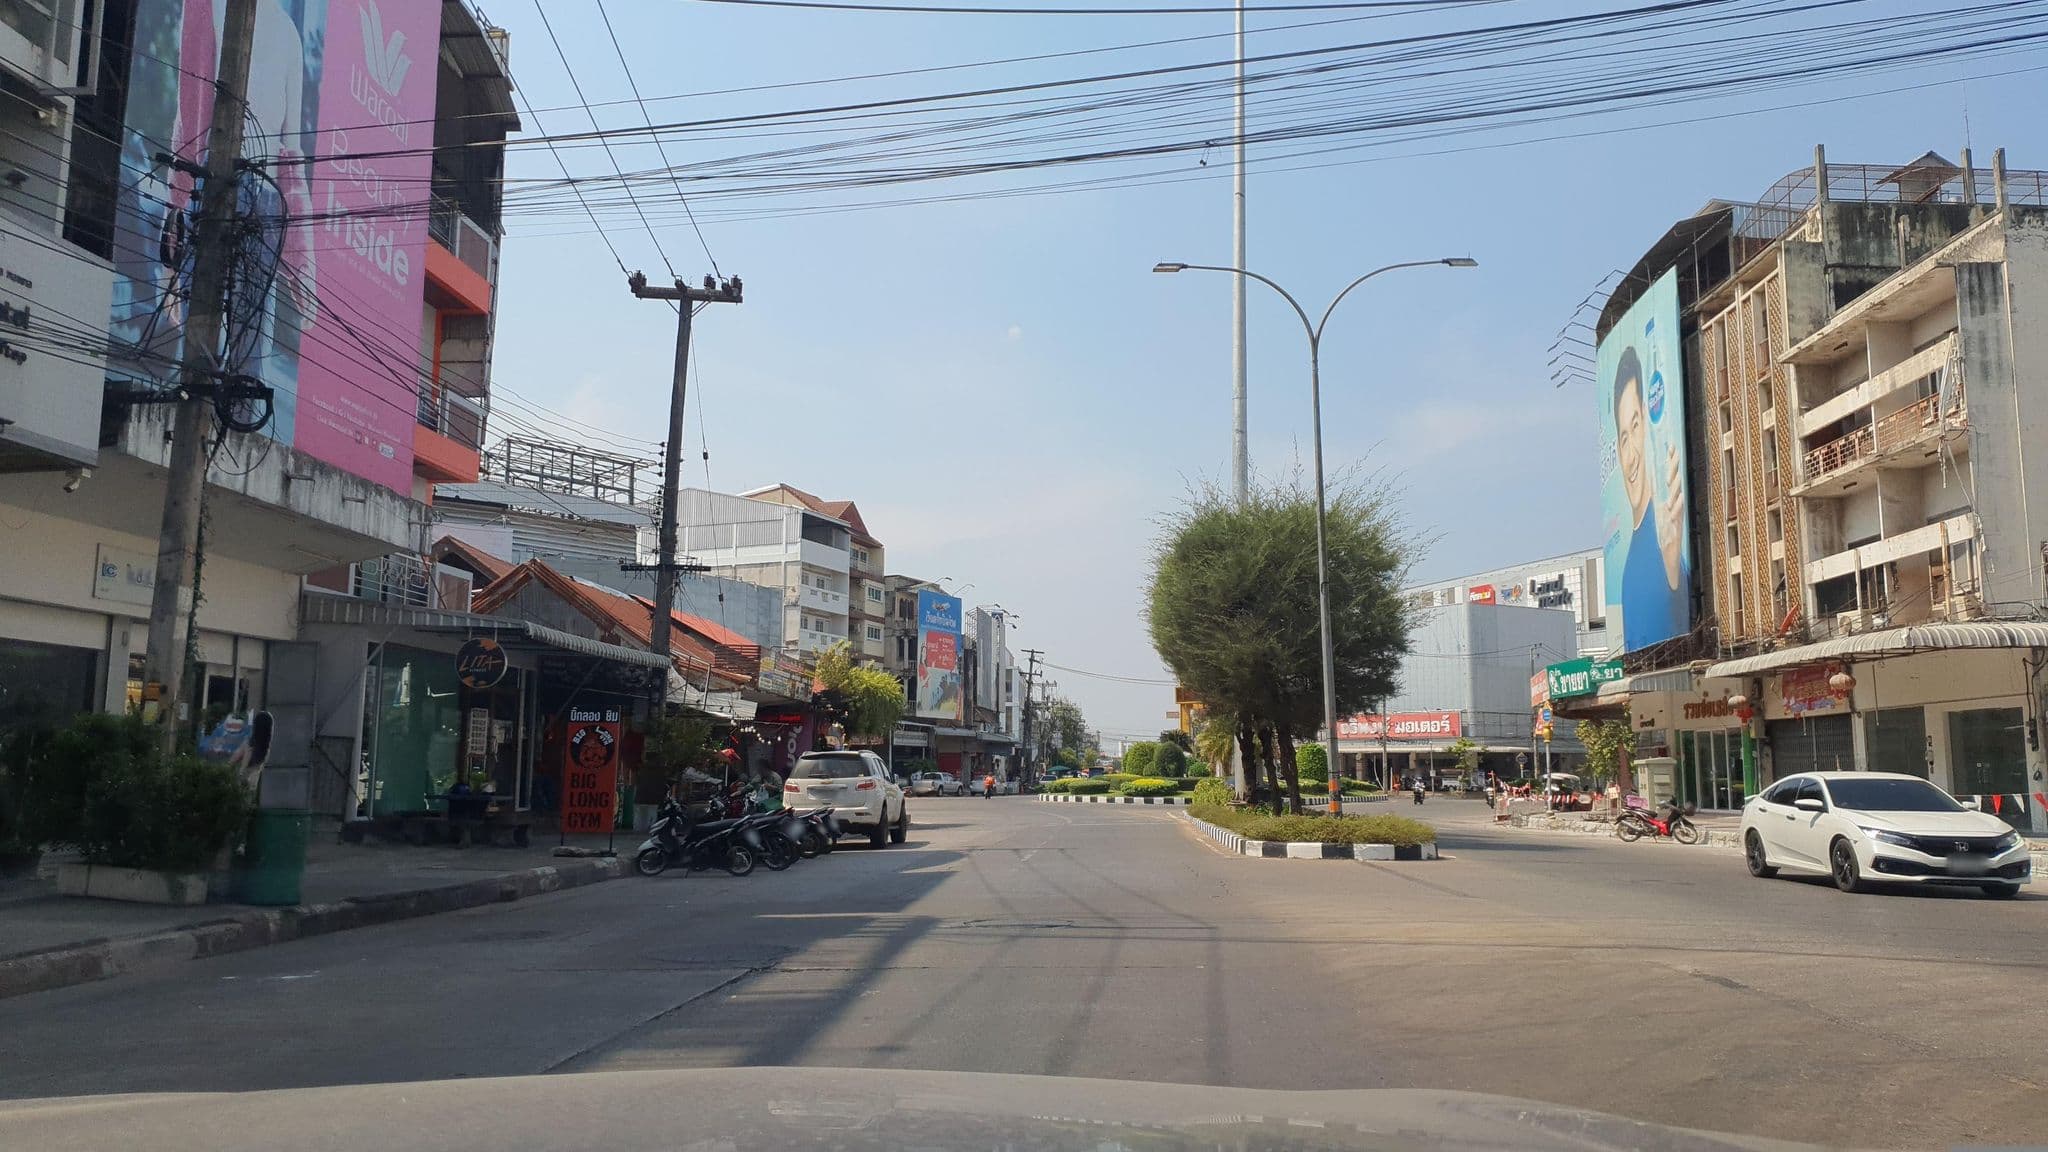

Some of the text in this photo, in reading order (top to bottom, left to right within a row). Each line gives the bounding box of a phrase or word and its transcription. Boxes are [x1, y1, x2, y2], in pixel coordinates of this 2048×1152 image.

[331, 127, 411, 236] Beauty
[326, 181, 409, 286] Inside
[1530, 574, 1563, 597] Land
[1538, 588, 1573, 608] mark
[1561, 671, 1589, 693] ขายยา
[1604, 667, 1623, 679] ยา
[1395, 714, 1450, 735] มอเตอร์
[572, 728, 586, 744] BIG
[570, 772, 596, 789] BIG
[569, 791, 609, 808] LONG
[568, 812, 601, 829] GYM
